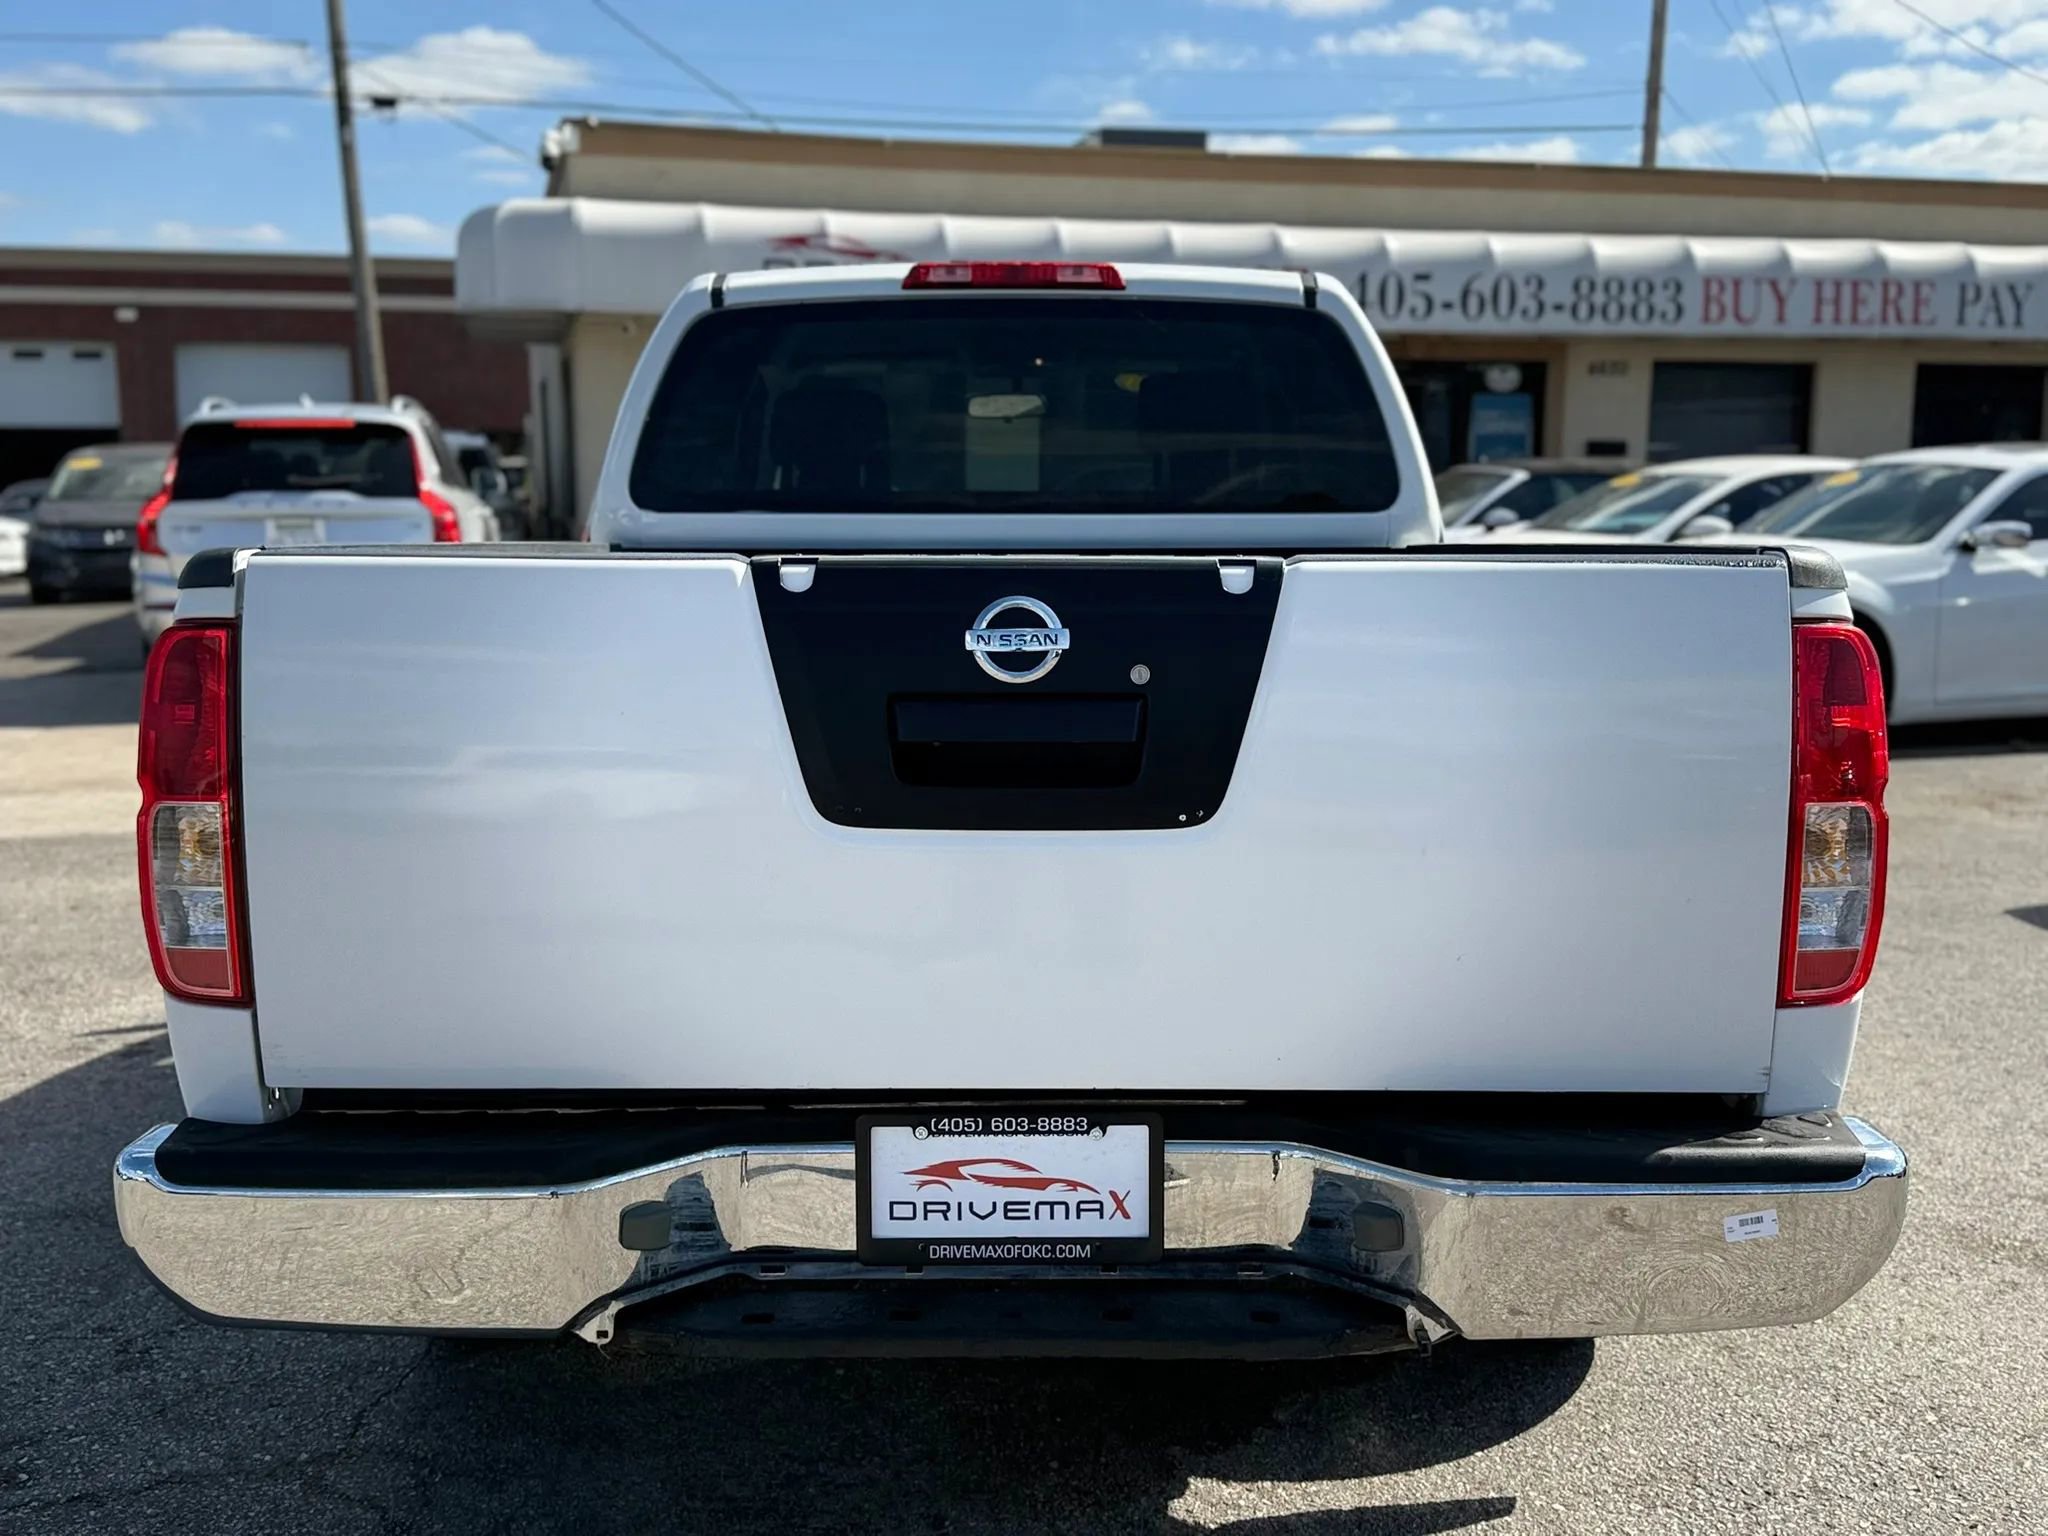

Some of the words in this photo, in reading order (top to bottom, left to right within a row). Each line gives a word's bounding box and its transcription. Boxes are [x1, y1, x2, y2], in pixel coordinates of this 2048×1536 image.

[1700, 275, 1797, 326] BUY
[1811, 277, 1938, 327] HERE
[1955, 280, 2034, 329] PAY
[976, 632, 1059, 647] NISSAN
[931, 1117, 983, 1132] (405)
[991, 1116, 1088, 1132] 603-8883
[889, 1189, 1132, 1221] DRIVEMAX
[929, 1244, 1091, 1259] DRIVEMAXOFOKC.COM
